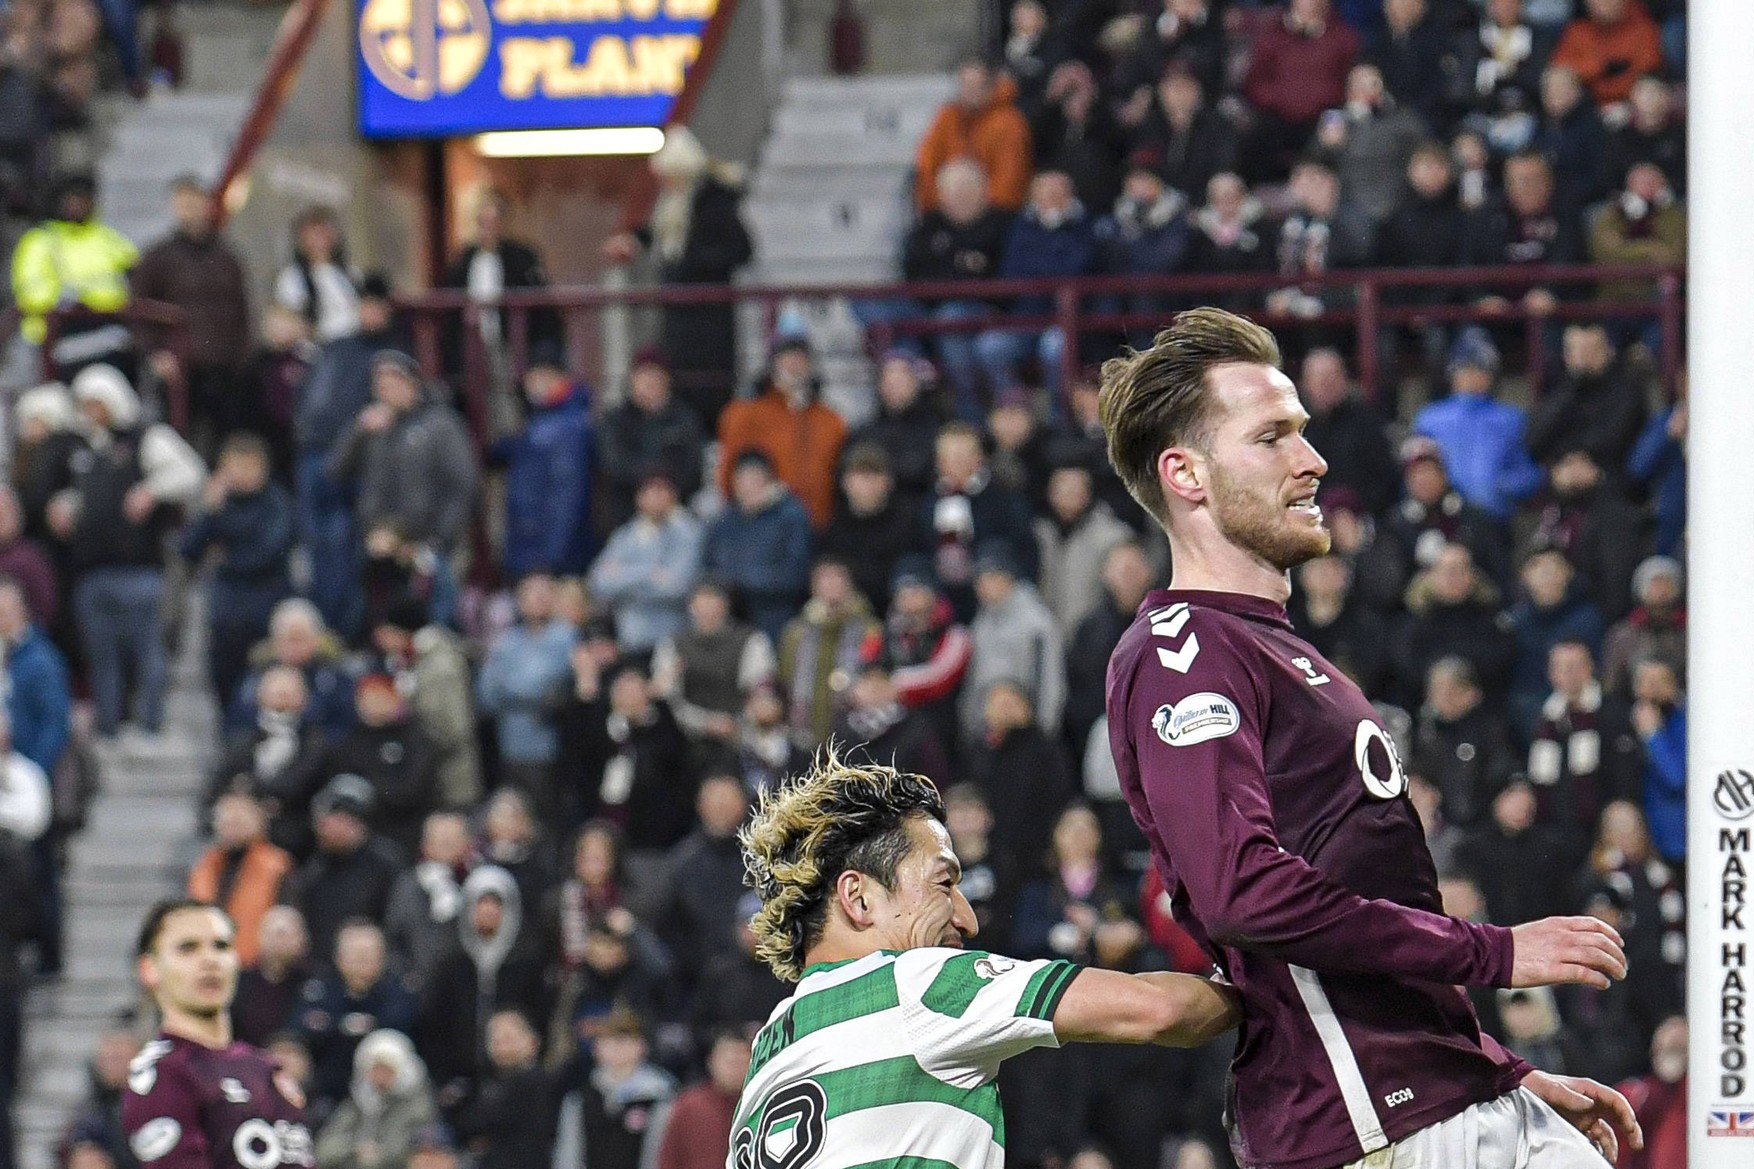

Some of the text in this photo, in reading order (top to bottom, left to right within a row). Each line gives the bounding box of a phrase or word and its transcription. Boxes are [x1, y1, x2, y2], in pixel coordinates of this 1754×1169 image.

[502, 35, 702, 98] PLAN
[1209, 704, 1231, 715] HILL
[1718, 827, 1751, 931] MARK
[1719, 941, 1747, 1098] HARROD
